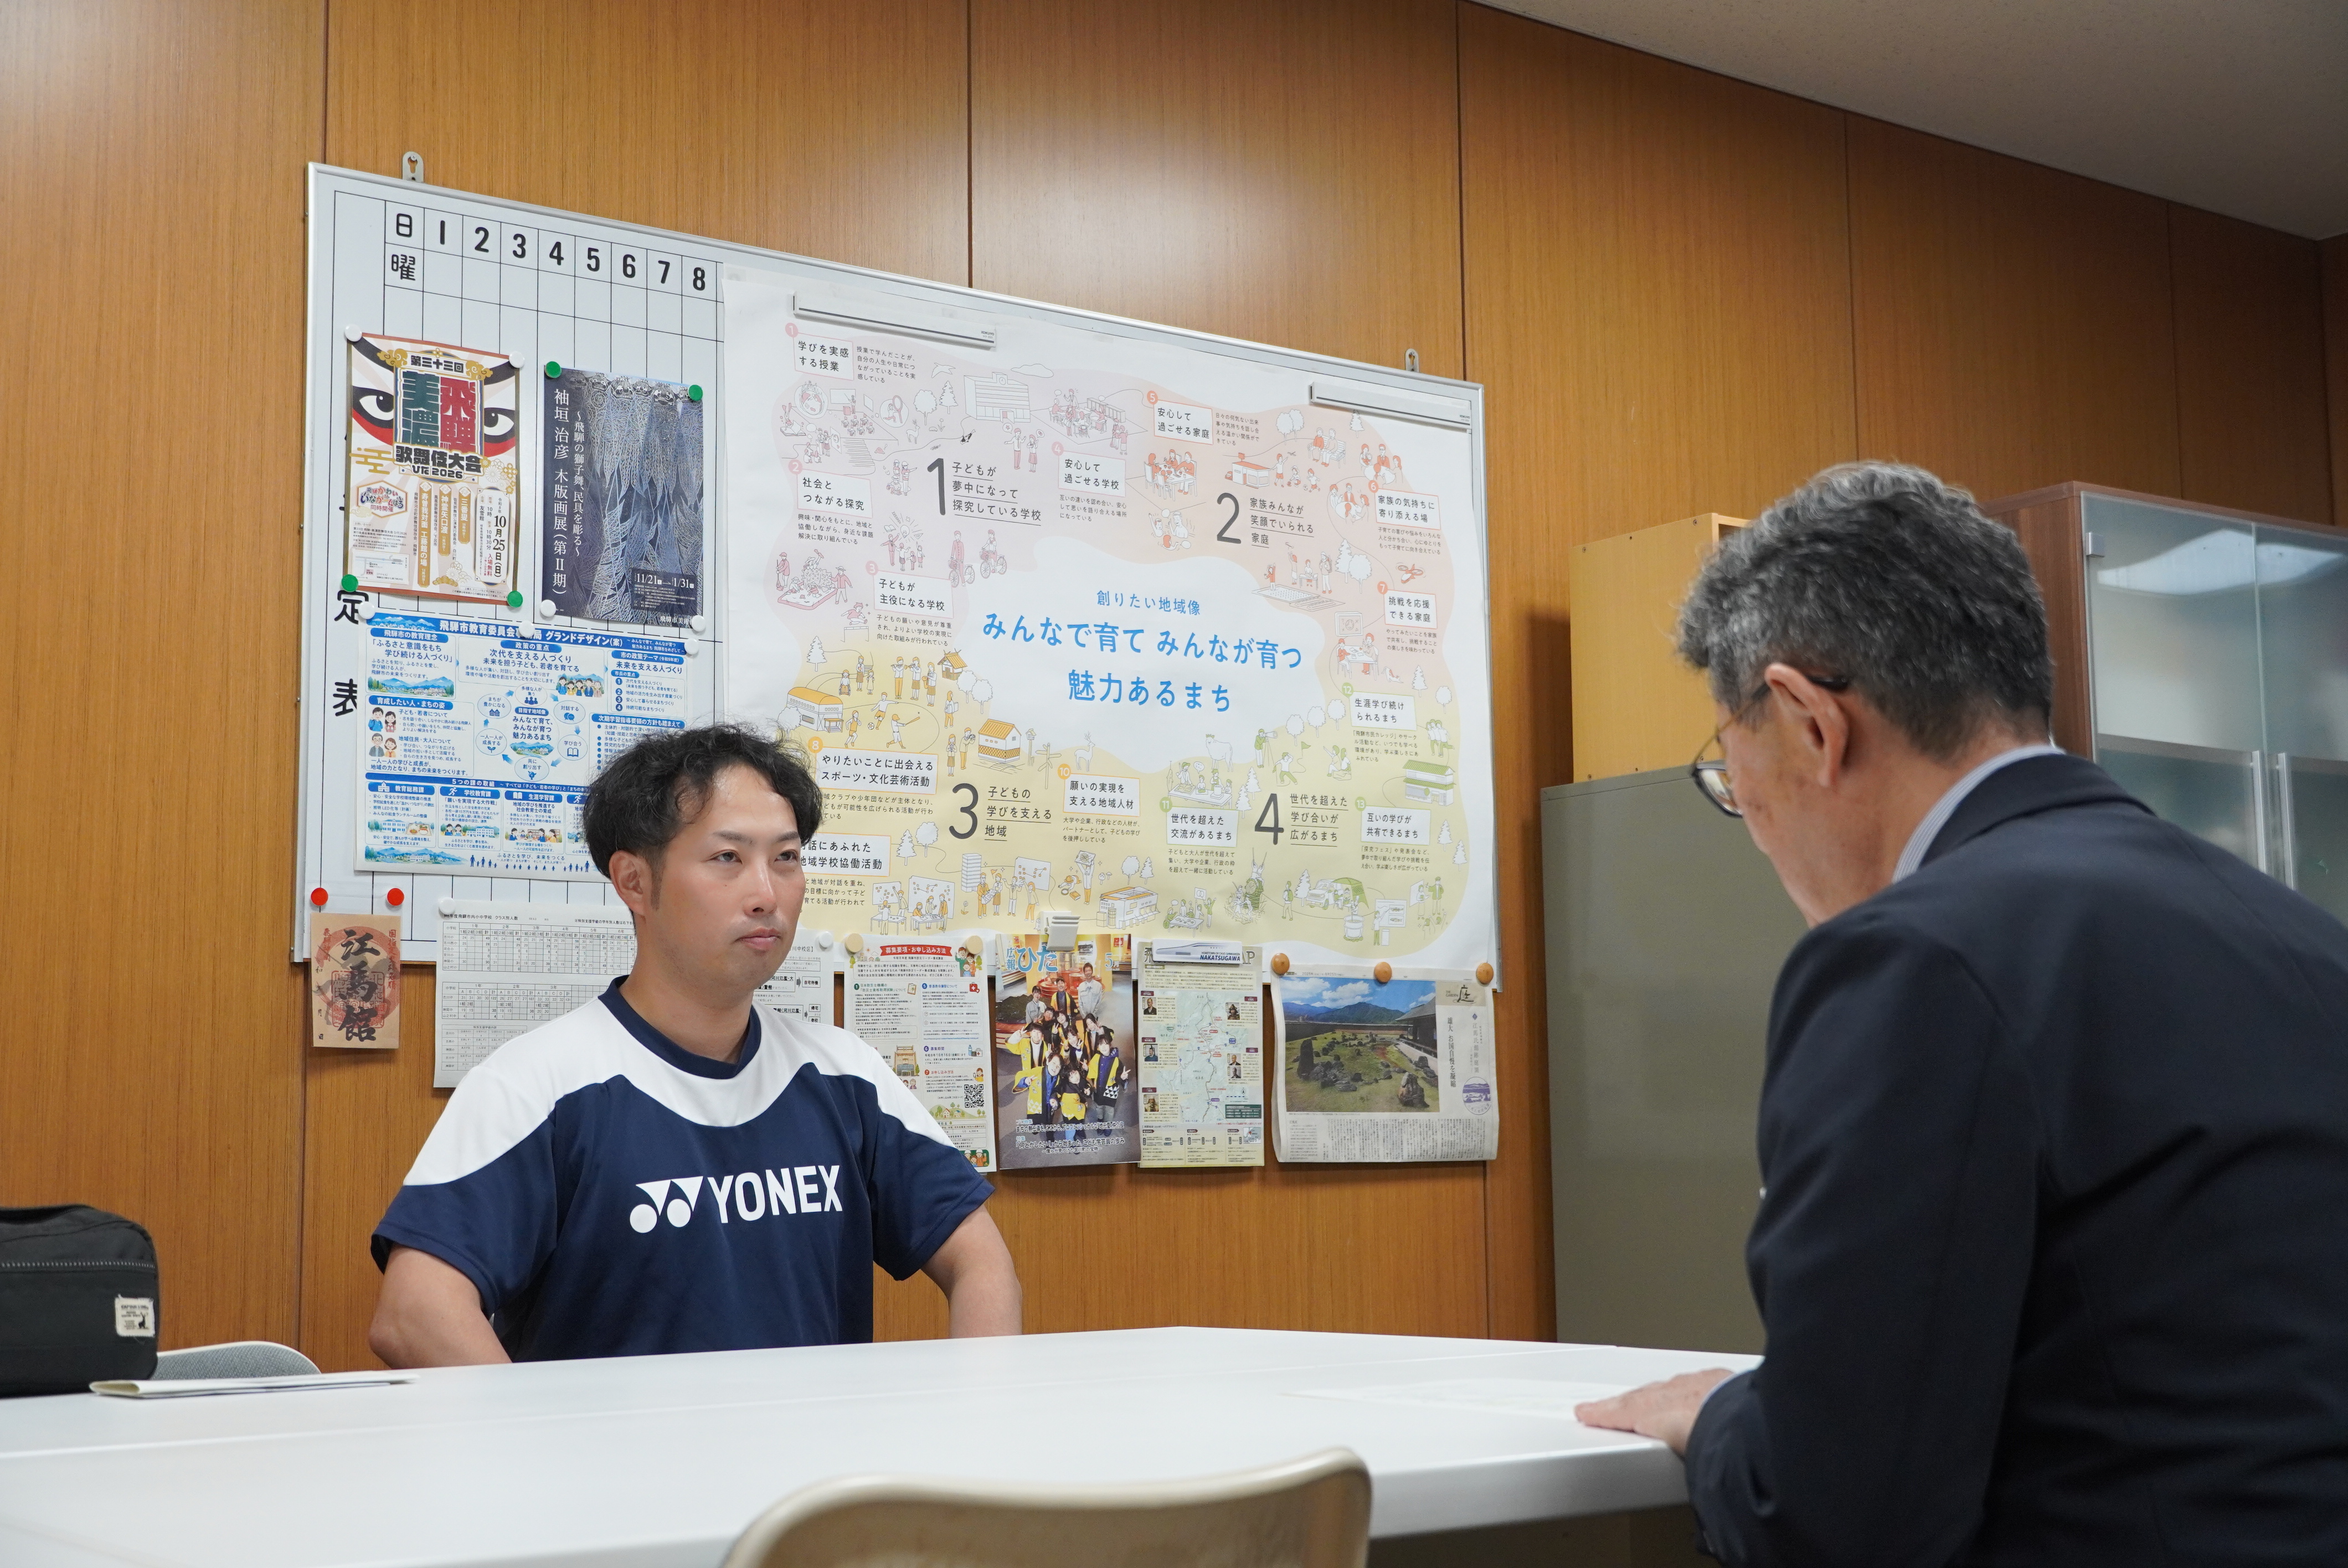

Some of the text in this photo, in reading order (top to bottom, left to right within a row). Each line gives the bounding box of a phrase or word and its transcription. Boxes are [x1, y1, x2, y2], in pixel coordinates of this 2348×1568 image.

[397, 214, 705, 291] 日 1 2 3 4 5 6 7 8
[391, 254, 416, 281] 曜
[798, 341, 849, 358] 学びを実感
[857, 347, 915, 362] 授業で学んだことが、
[411, 355, 464, 373] 第三十三回
[799, 356, 839, 372] する授業
[1157, 408, 1191, 421] 安心して
[1157, 422, 1209, 439] 過ごせる家庭
[395, 446, 481, 473] 歌舞伎大会
[1065, 459, 1100, 473] 安心して
[412, 465, 463, 479] ひだ 2026
[952, 462, 997, 477] 子どもが
[802, 477, 832, 490] 社会と
[927, 457, 945, 515] 1
[952, 481, 1018, 498] 夢中になって
[1064, 474, 1120, 491] 過ごせる学校
[804, 494, 864, 511] つながる探究
[1250, 498, 1304, 515] 家族みんなが
[1378, 496, 1435, 509] 家族の気持ちに
[952, 499, 1042, 522] 探究している学校
[1379, 509, 1428, 523] 寄り添える場
[1217, 492, 1242, 545] 2
[1250, 515, 1314, 534] 笑顔でいられる
[798, 533, 858, 545] 解決に取り組んでいる
[1252, 533, 1269, 545] 家庭
[637, 574, 657, 584] 11/21
[674, 578, 689, 588] 1/31
[879, 579, 915, 590] 子どもが
[880, 594, 945, 611] 主役になる学校
[1096, 590, 1201, 616] 創りたい地域像
[1389, 596, 1430, 609] 挑戦を応援
[1389, 611, 1431, 623] できる家庭
[384, 630, 437, 641] 飛騨市の教育理念
[439, 620, 542, 640] 飛騨市教育委員会局
[372, 639, 441, 652] 「ふるさと意識をもち
[515, 641, 549, 651] 政策の重点
[982, 612, 1302, 669] みんなで育て みんなが育つ
[385, 649, 452, 663] 学び続ける人づくり」
[490, 649, 571, 663] 次代を支える人づくり
[483, 657, 579, 672] 未来を担う子ども、若者を育てる
[616, 661, 682, 674] 未来を支える人づくり
[371, 670, 428, 679] 飛騨市の未来をつくります。
[1068, 669, 1230, 713] 魅力あるまち
[377, 698, 445, 709] 育成したい人・まちの姿
[626, 697, 674, 705] 安心して暮らせるまちづくり
[1355, 699, 1404, 710] 生涯学び続け
[399, 709, 447, 718] 子ども・若者について
[518, 707, 546, 716] 目指す地域像
[1357, 713, 1397, 723] られるまち
[398, 735, 451, 745] 地域住民・大人について
[371, 765, 468, 775] 地域の力となり、まちの未来をつくります。
[822, 755, 933, 771] やりたいことに出会える
[822, 771, 929, 787] スポーツ・文化芸術活動
[988, 786, 1031, 798] 子どもの
[1070, 781, 1124, 793] 願いの実現を
[1070, 796, 1134, 809] 支える地域人材
[1290, 794, 1347, 807] 世代を超えた
[949, 783, 979, 839] 3
[987, 806, 1051, 819] 学びを支える
[1291, 812, 1338, 824] 学び合いが
[1171, 814, 1224, 826] 世代を超えた
[1255, 793, 1284, 845] 4
[1367, 813, 1412, 824] 互いの学びが
[985, 825, 1007, 837] 地域
[1171, 829, 1232, 840] 交流があるまち
[1290, 830, 1337, 842] 広がるまち
[1367, 828, 1418, 839] 共有できるまち
[1063, 835, 1105, 843] を後押ししている
[1006, 948, 1016, 970] 広報
[707, 1165, 842, 1223] YONEX
